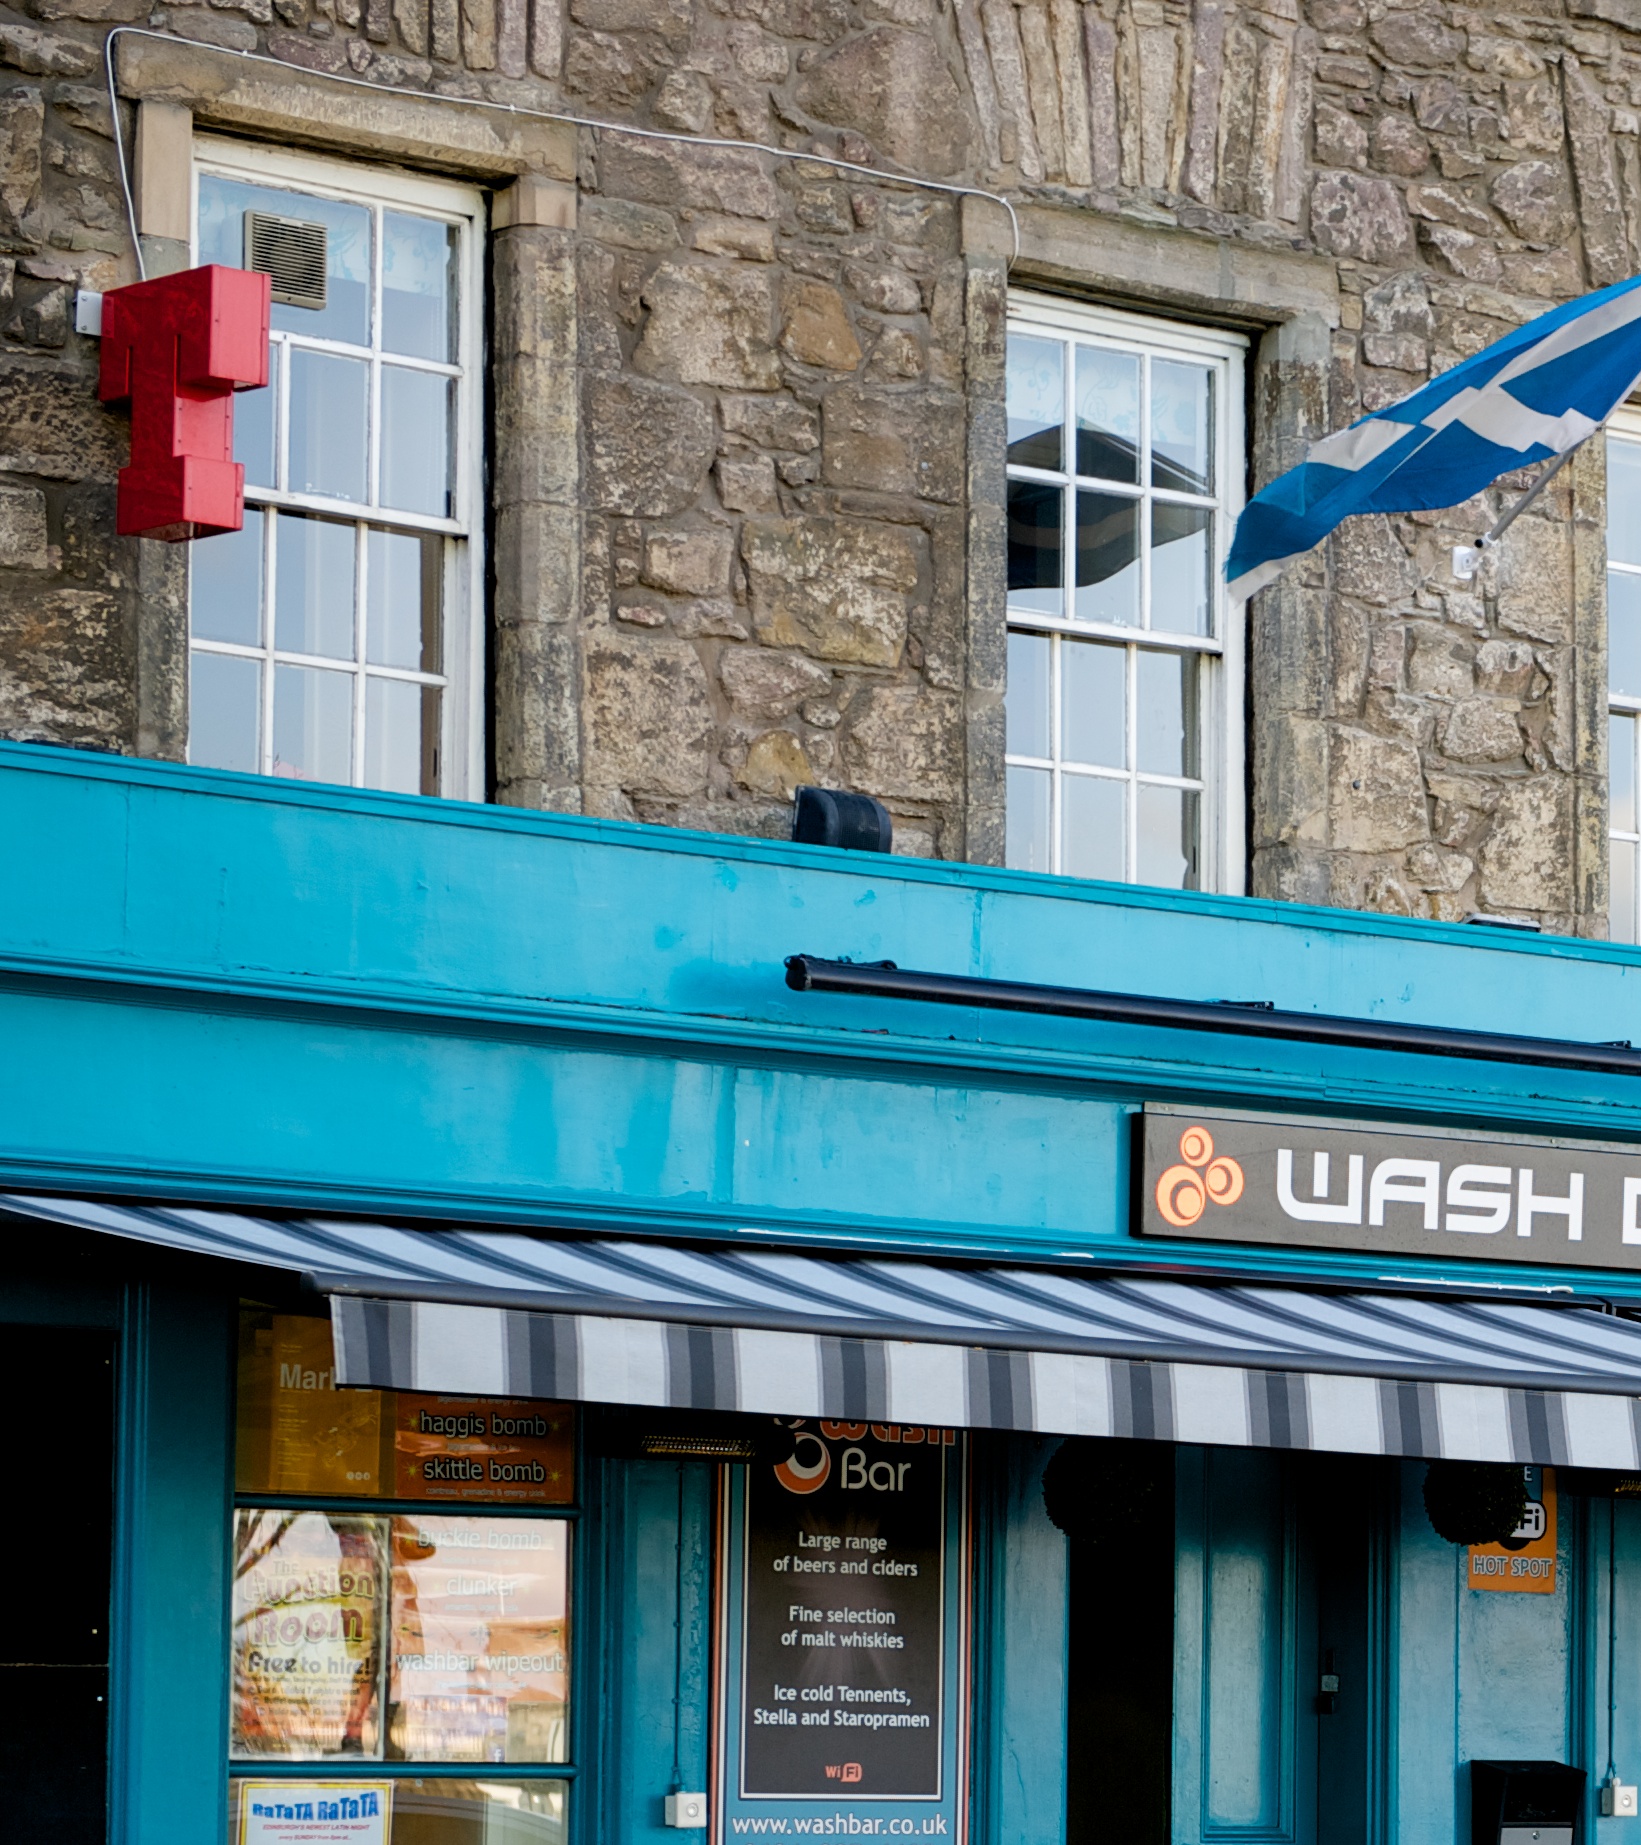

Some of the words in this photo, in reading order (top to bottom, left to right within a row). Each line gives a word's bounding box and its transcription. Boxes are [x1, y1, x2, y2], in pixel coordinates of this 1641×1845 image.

[1277, 1148, 1584, 1242] WASH
[420, 1409, 485, 1438] haggis
[492, 1413, 547, 1436] bomb
[424, 1457, 483, 1479] skittle
[489, 1459, 545, 1481] bomb
[841, 1447, 911, 1491] Bar
[417, 1526, 480, 1548] buckie
[487, 1528, 542, 1550] bomb
[799, 1531, 841, 1551] Large
[845, 1536, 887, 1553] range
[773, 1555, 790, 1572] of
[793, 1556, 836, 1573] beers
[840, 1558, 868, 1575] and
[872, 1559, 918, 1576] ciders
[1473, 1555, 1508, 1576] HOT
[1511, 1557, 1553, 1578] SPOT
[447, 1575, 518, 1596] clunker
[789, 1605, 823, 1622] Fine
[827, 1607, 896, 1624] selection
[781, 1629, 798, 1646] of
[801, 1631, 836, 1647] malt
[840, 1631, 904, 1649] whiskies
[301, 1656, 321, 1674] to
[328, 1656, 370, 1675] hire!
[395, 1650, 479, 1672] washbar
[484, 1652, 564, 1676] wipeout
[774, 1684, 797, 1701] Ice
[801, 1684, 834, 1701] cold
[837, 1686, 911, 1706] Tennents,
[753, 1708, 797, 1725] Stella
[801, 1709, 830, 1726] and
[833, 1709, 930, 1730] Staropramen
[732, 1813, 948, 1835] www.washbar.co.uk
